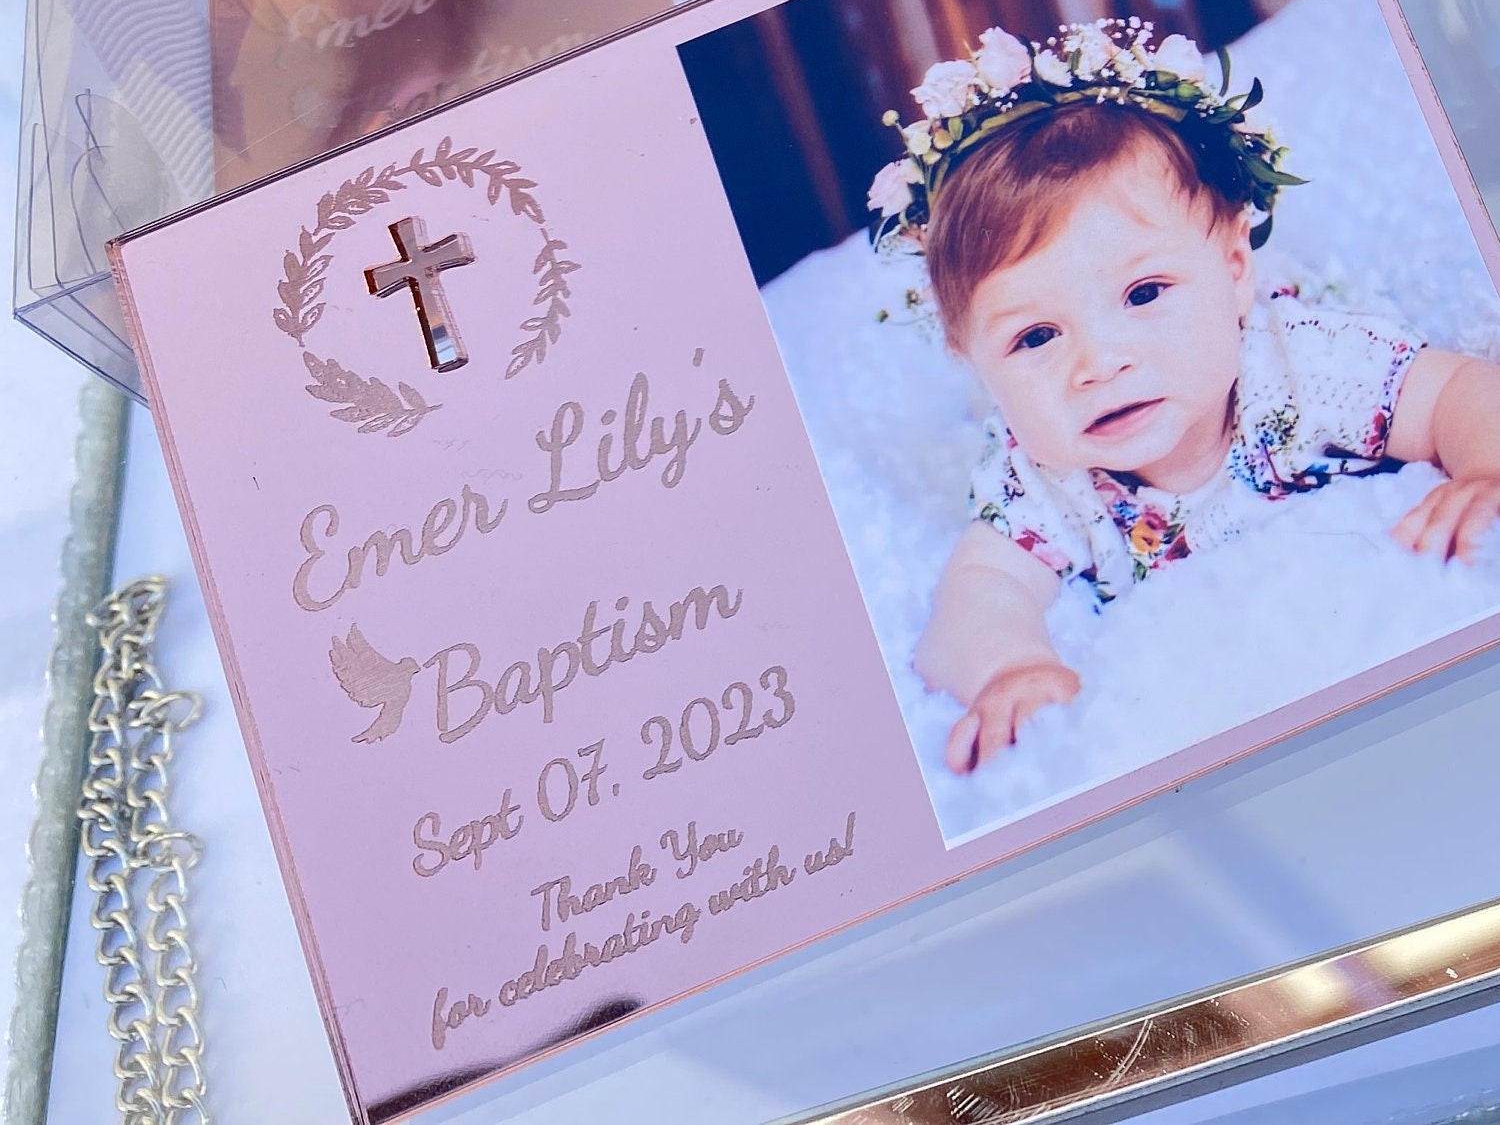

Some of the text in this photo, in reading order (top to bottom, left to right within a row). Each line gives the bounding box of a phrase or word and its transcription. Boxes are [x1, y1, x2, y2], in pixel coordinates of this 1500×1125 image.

[292, 348, 755, 612] Emer Lily's
[424, 583, 742, 743] Baptism
[412, 788, 524, 878] Sept
[640, 665, 795, 781] 2023
[531, 821, 744, 932] Thank You
[431, 812, 856, 1050] for celebrating with us!
